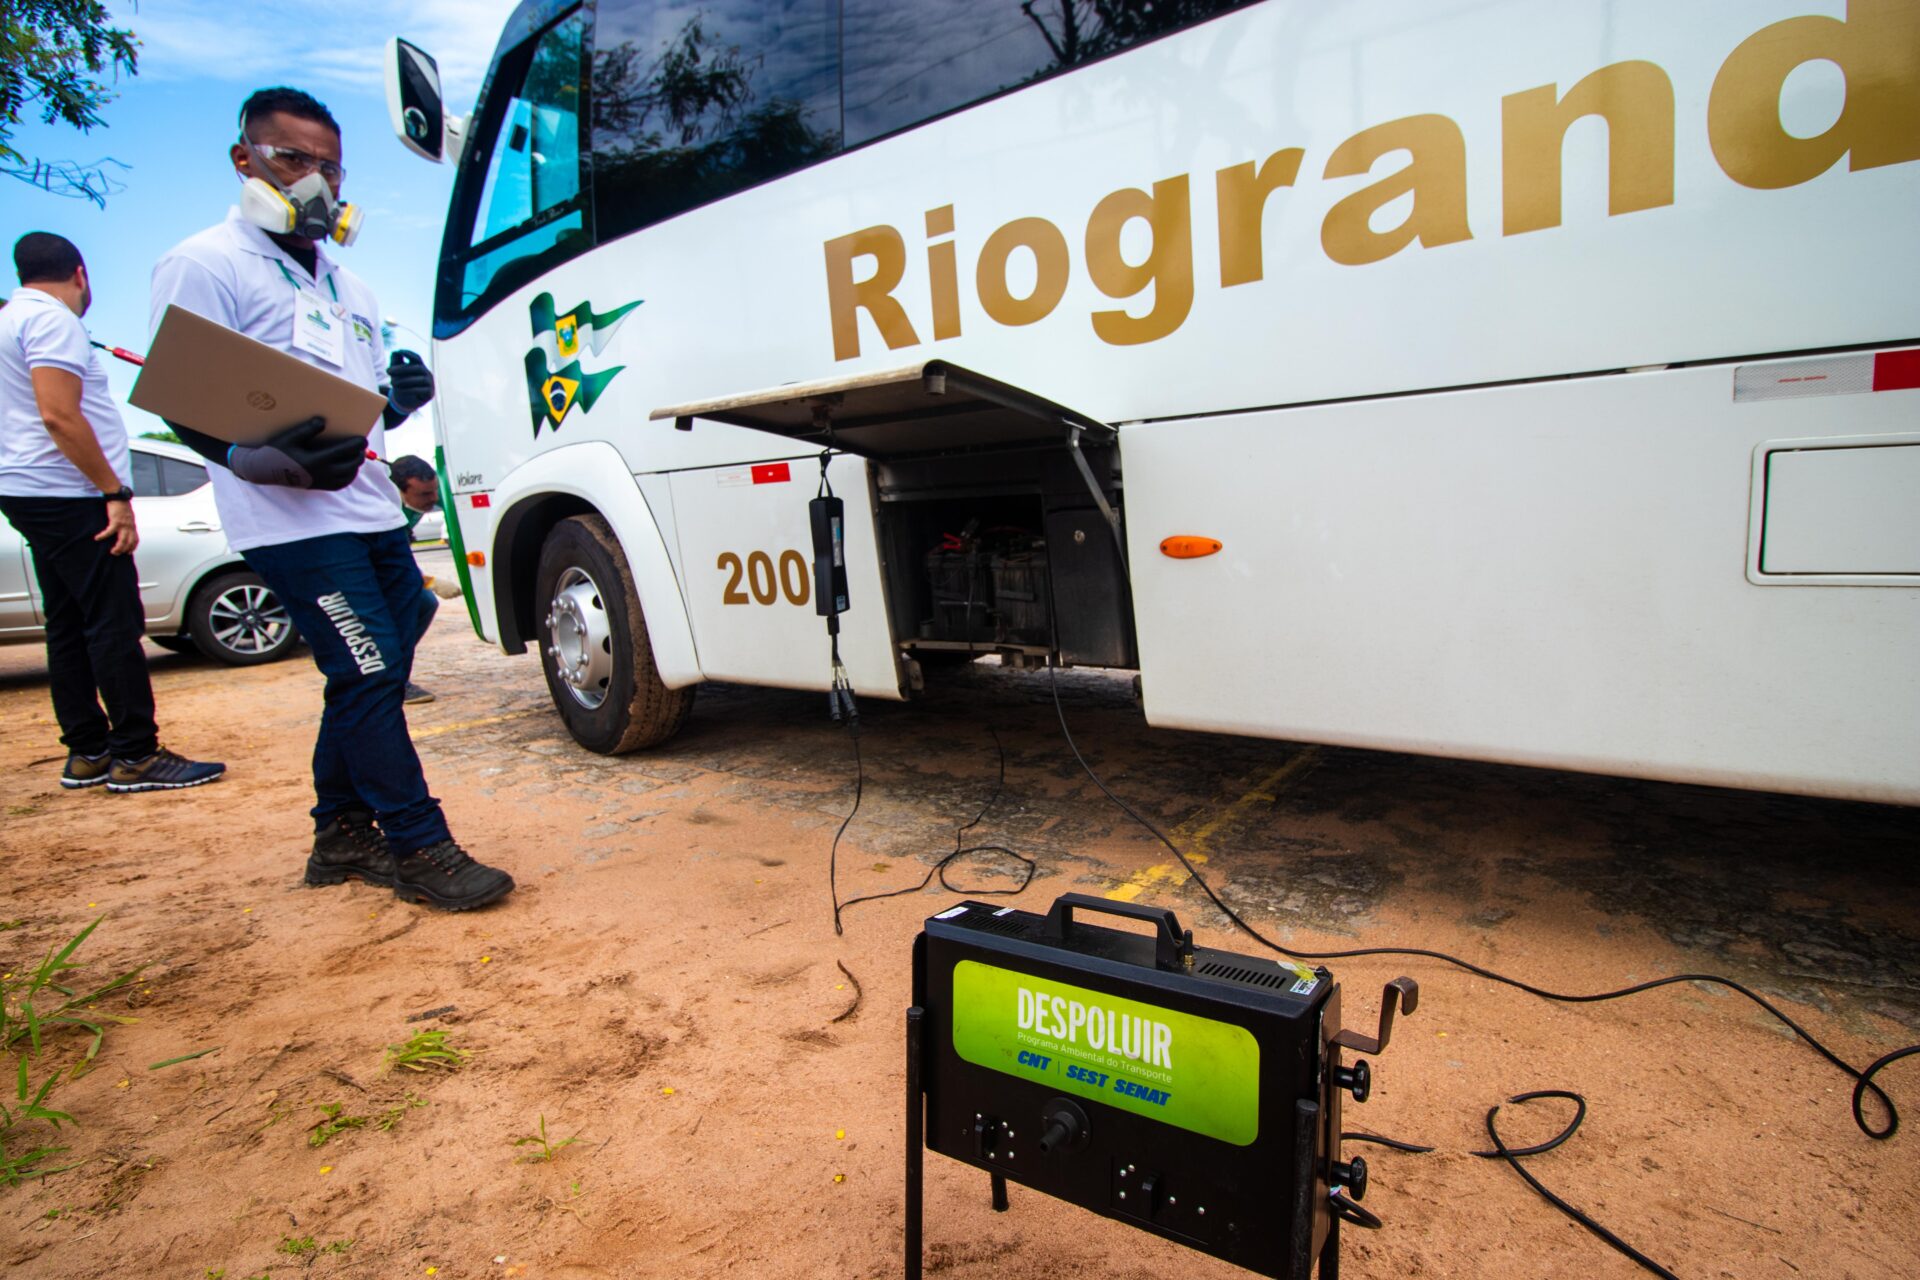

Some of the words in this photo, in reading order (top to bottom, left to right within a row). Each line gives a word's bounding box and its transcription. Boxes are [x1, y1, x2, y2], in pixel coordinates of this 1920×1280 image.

[823, 0, 1920, 362] Riogrand
[717, 549, 816, 606] 200
[317, 590, 387, 675] DESPOLUIR
[1017, 1031, 1058, 1051] Programa
[1061, 1043, 1104, 1064] Ambiental
[1106, 1055, 1119, 1067] do
[1121, 1060, 1173, 1084] Transporte
[1018, 987, 1173, 1069] DESPOLUIR
[1017, 1050, 1052, 1071] CNT
[1066, 1065, 1110, 1087] SEST
[1113, 1078, 1172, 1107] SENAT
